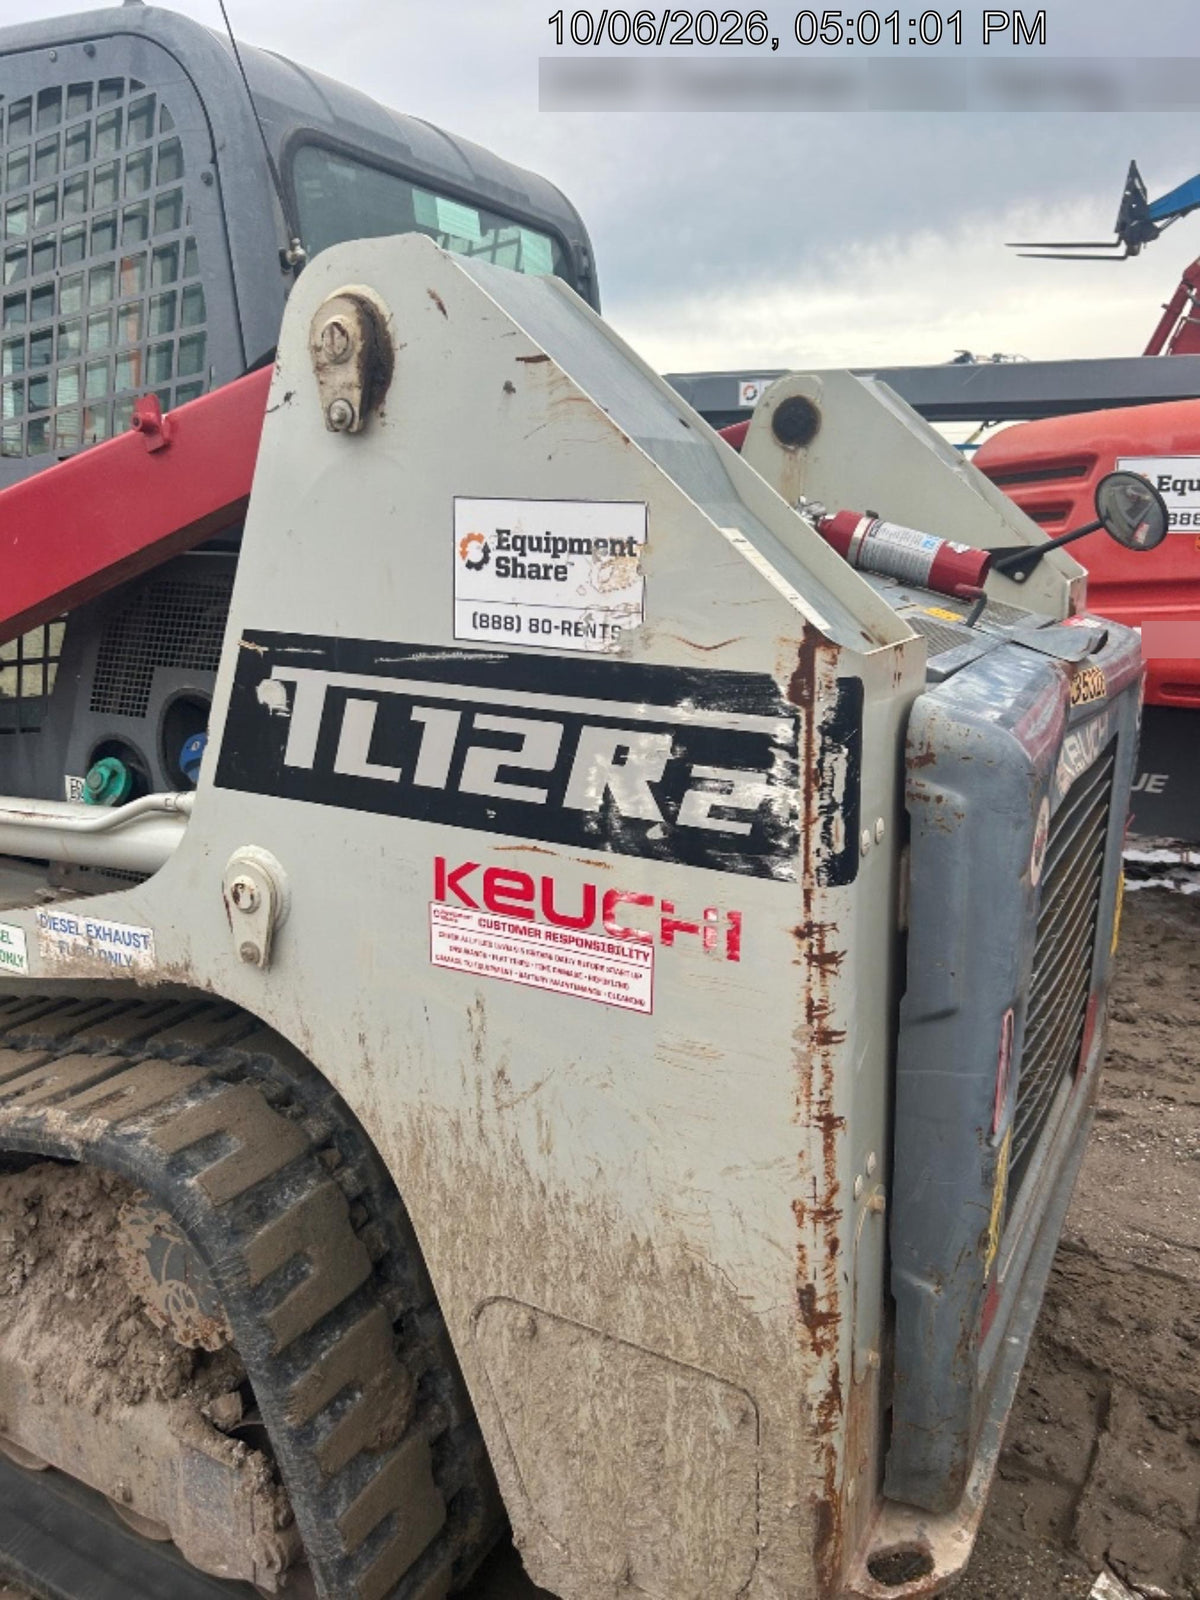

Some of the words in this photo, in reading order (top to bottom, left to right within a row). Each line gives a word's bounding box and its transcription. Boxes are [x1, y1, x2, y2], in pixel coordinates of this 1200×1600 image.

[495, 529, 637, 558] Equipment
[495, 556, 568, 581] Share
[472, 611, 522, 634] (888)
[528, 617, 622, 639] 80-RENTS
[40, 912, 83, 936] DIESEL
[86, 924, 149, 949] EXHAUST
[478, 917, 542, 939] CUSTOMER
[545, 931, 650, 962] RESPONSIBILITY
[98, 949, 132, 967] ONLY
